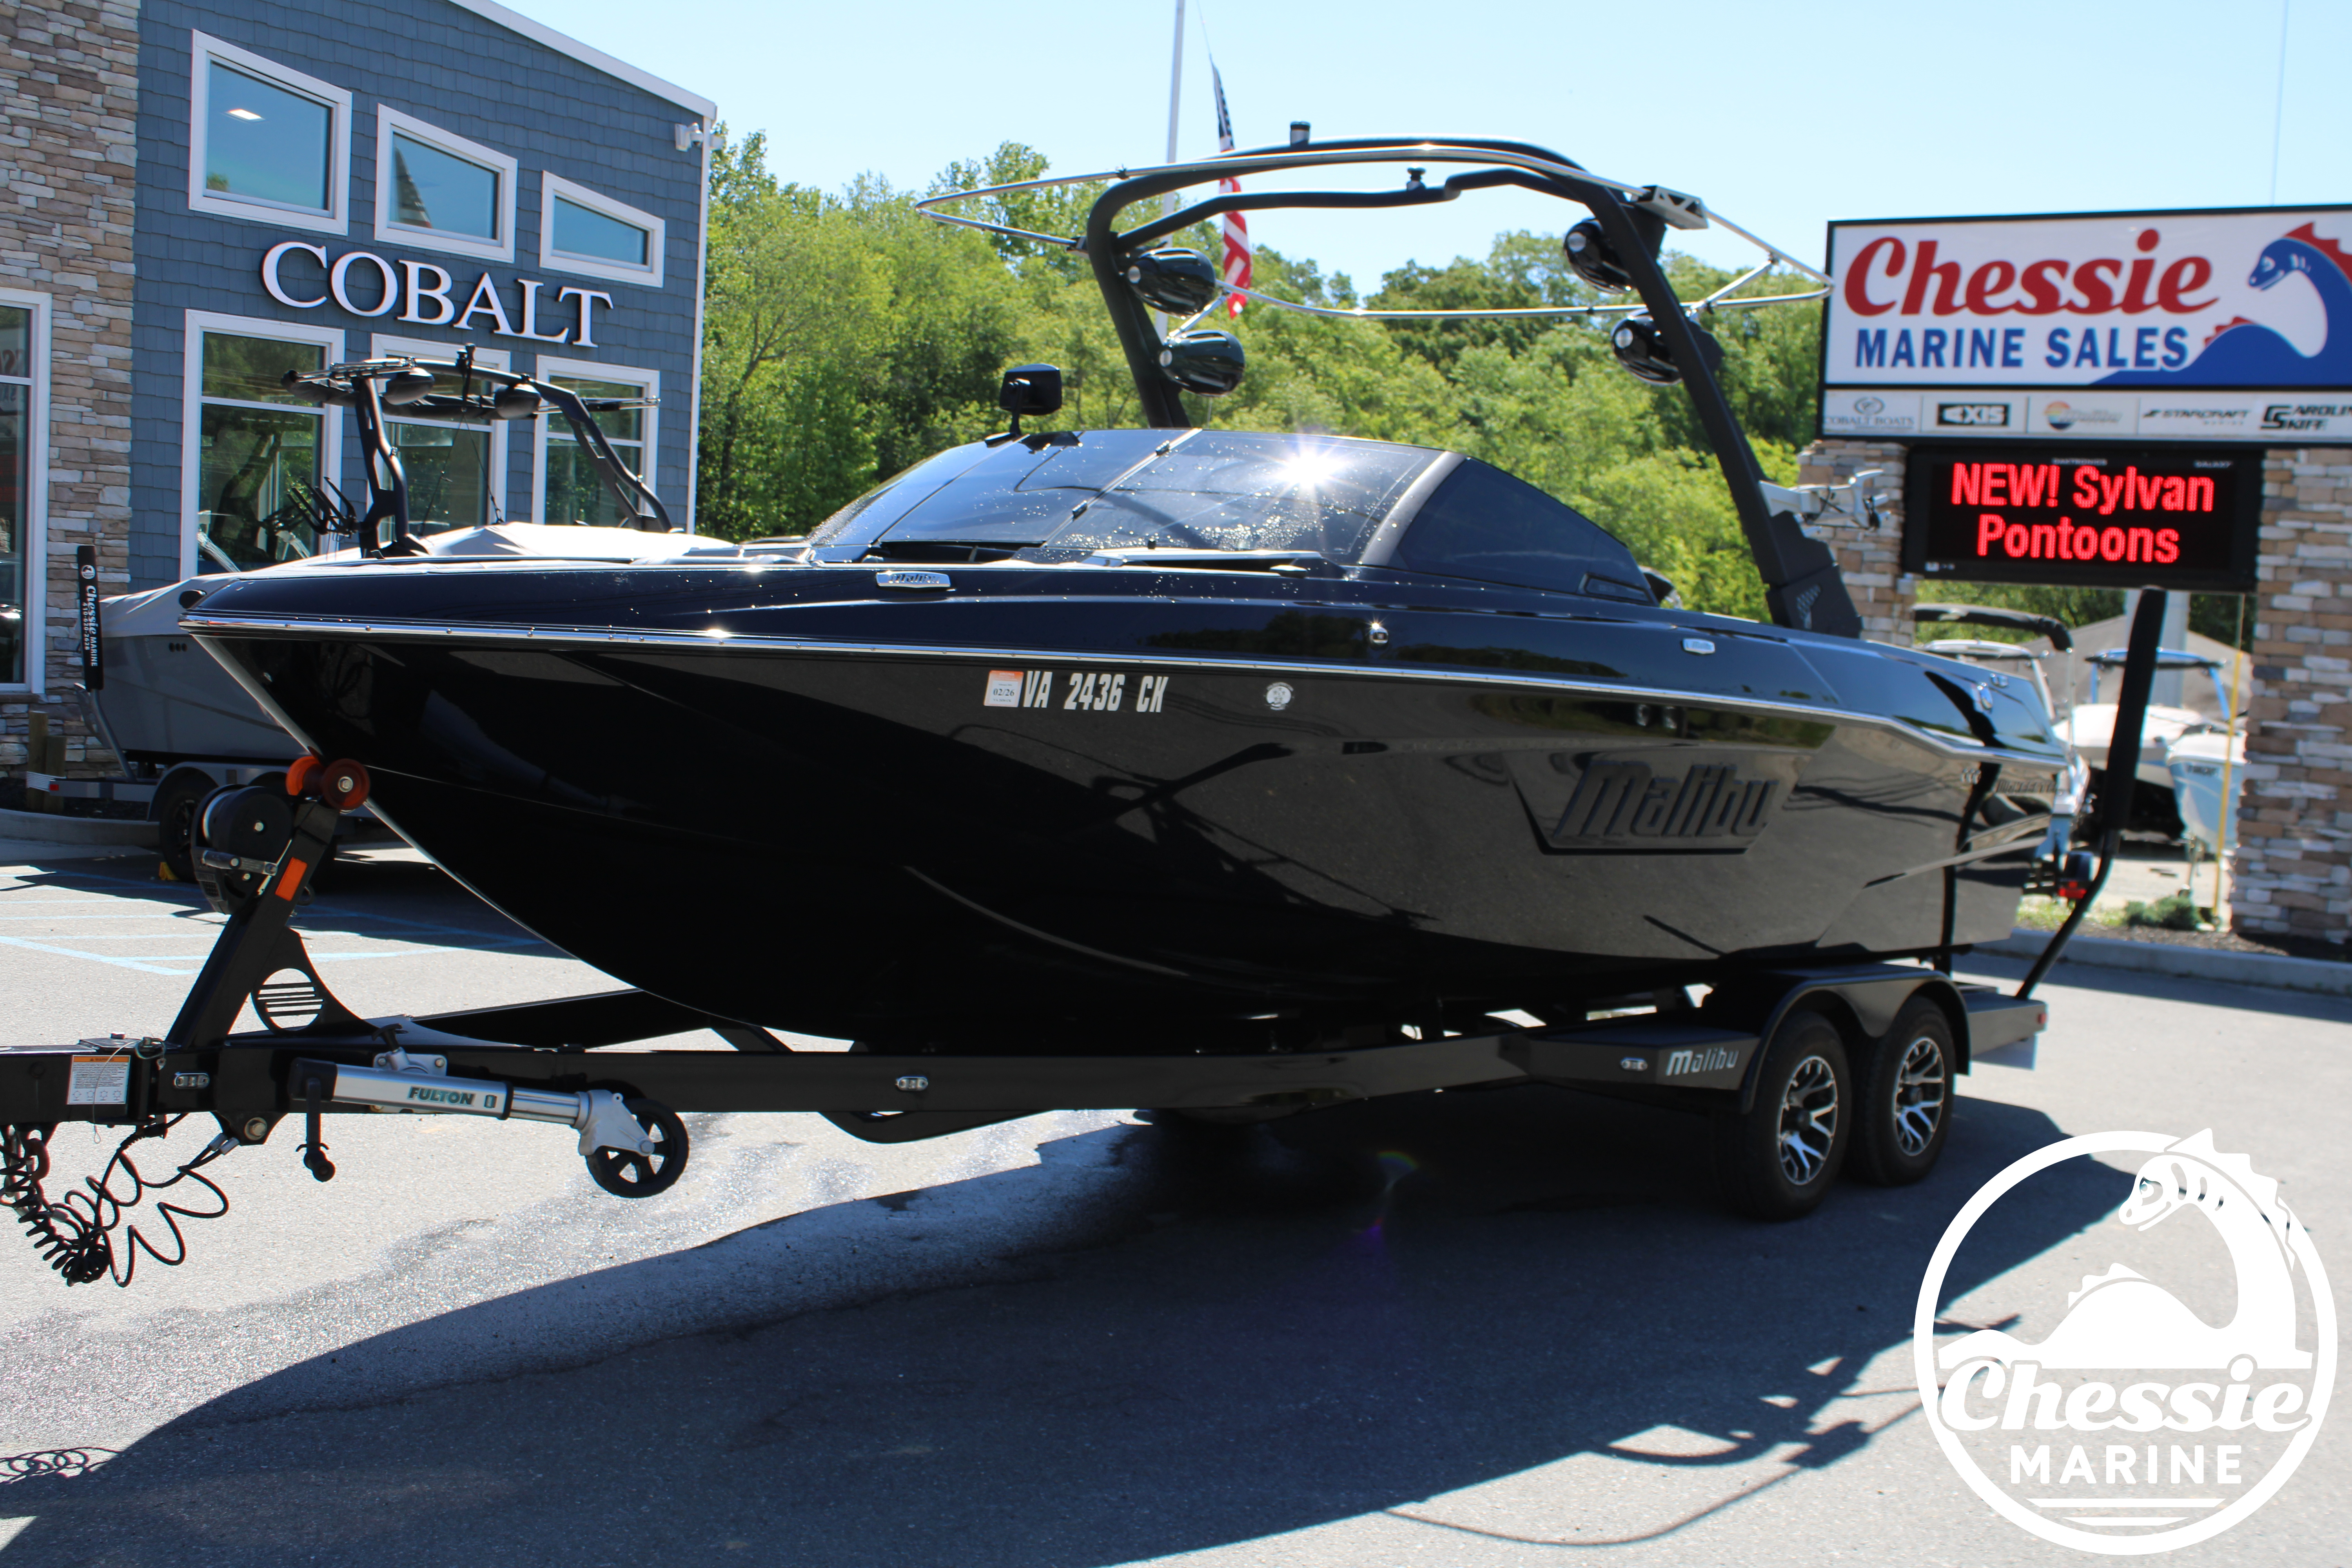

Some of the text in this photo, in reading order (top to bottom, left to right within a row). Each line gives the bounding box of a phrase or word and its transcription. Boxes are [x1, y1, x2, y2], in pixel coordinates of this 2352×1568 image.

[261, 241, 613, 348] COBALT
[1844, 229, 2220, 317] Chessie
[1855, 326, 2189, 368] MARINE SALES
[1951, 463, 2215, 515] NEW! Sylvan
[1977, 514, 2180, 563] Pontoons
[86, 585, 99, 635] Chessie
[90, 637, 98, 667] MARINE
[993, 688, 1015, 697] 02/26
[1023, 671, 1169, 713] VA 2436 CK
[1553, 760, 1779, 838] Malibu
[1666, 1047, 1739, 1076] Malibu
[408, 1086, 477, 1106] FULTON
